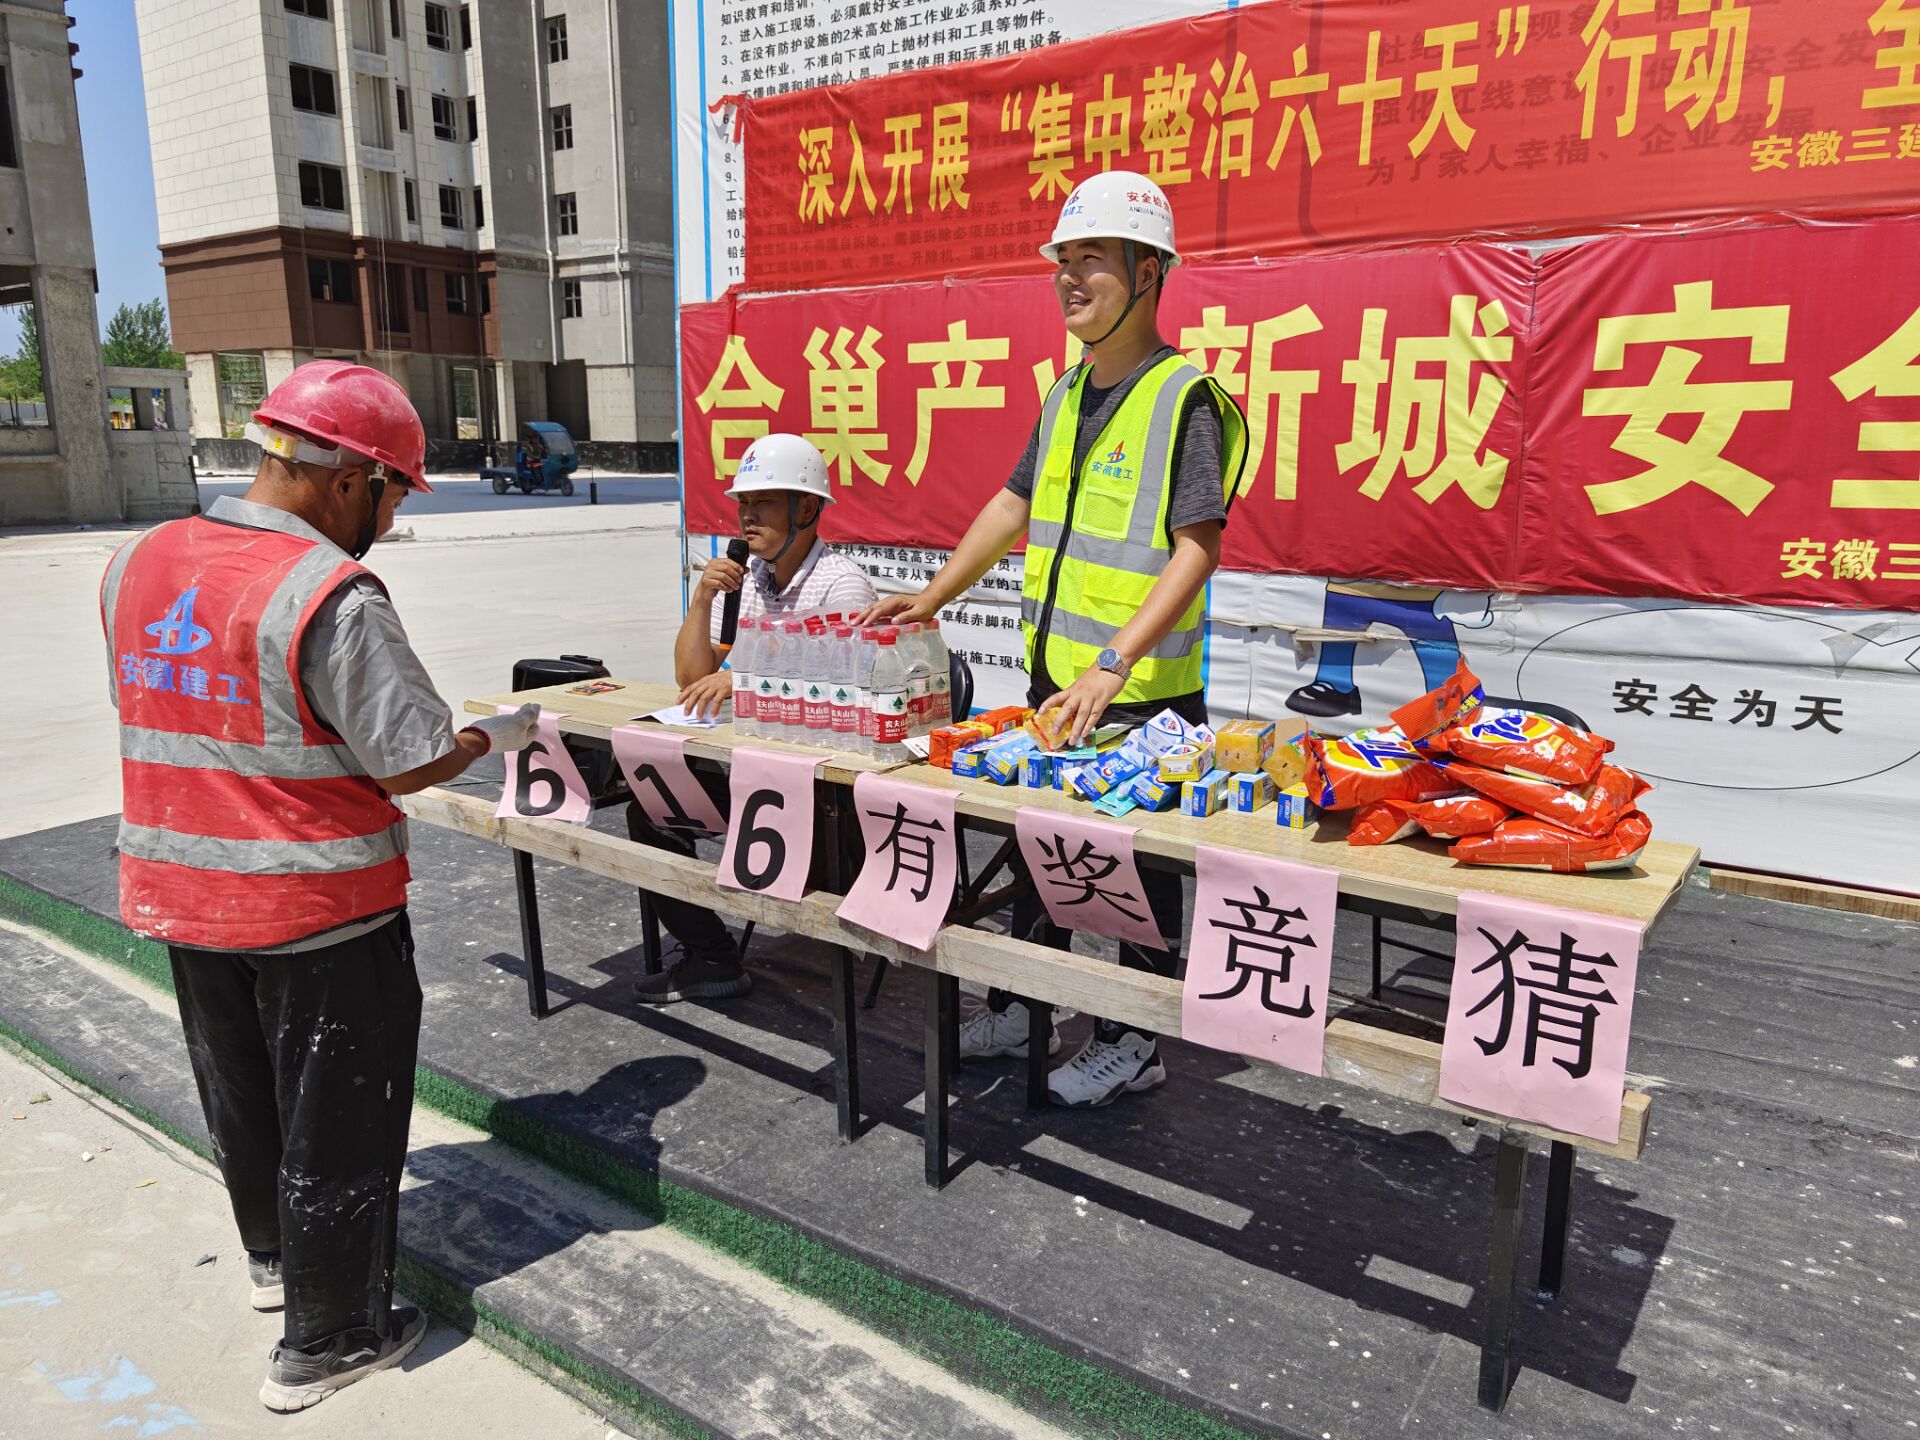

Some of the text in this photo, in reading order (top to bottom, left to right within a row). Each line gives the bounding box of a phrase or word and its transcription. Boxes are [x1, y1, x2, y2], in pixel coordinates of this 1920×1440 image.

[721, 0, 931, 46] 2、进入施工现场，必须戴好安全
[696, 279, 1920, 518] 合巢产新城安
[1779, 537, 1920, 582] 安徽三
[120, 652, 251, 704] 安徽建工
[1611, 677, 1844, 735] 安全为天
[514, 739, 1619, 1080] 6 1 6 有 奖 竞 猜
